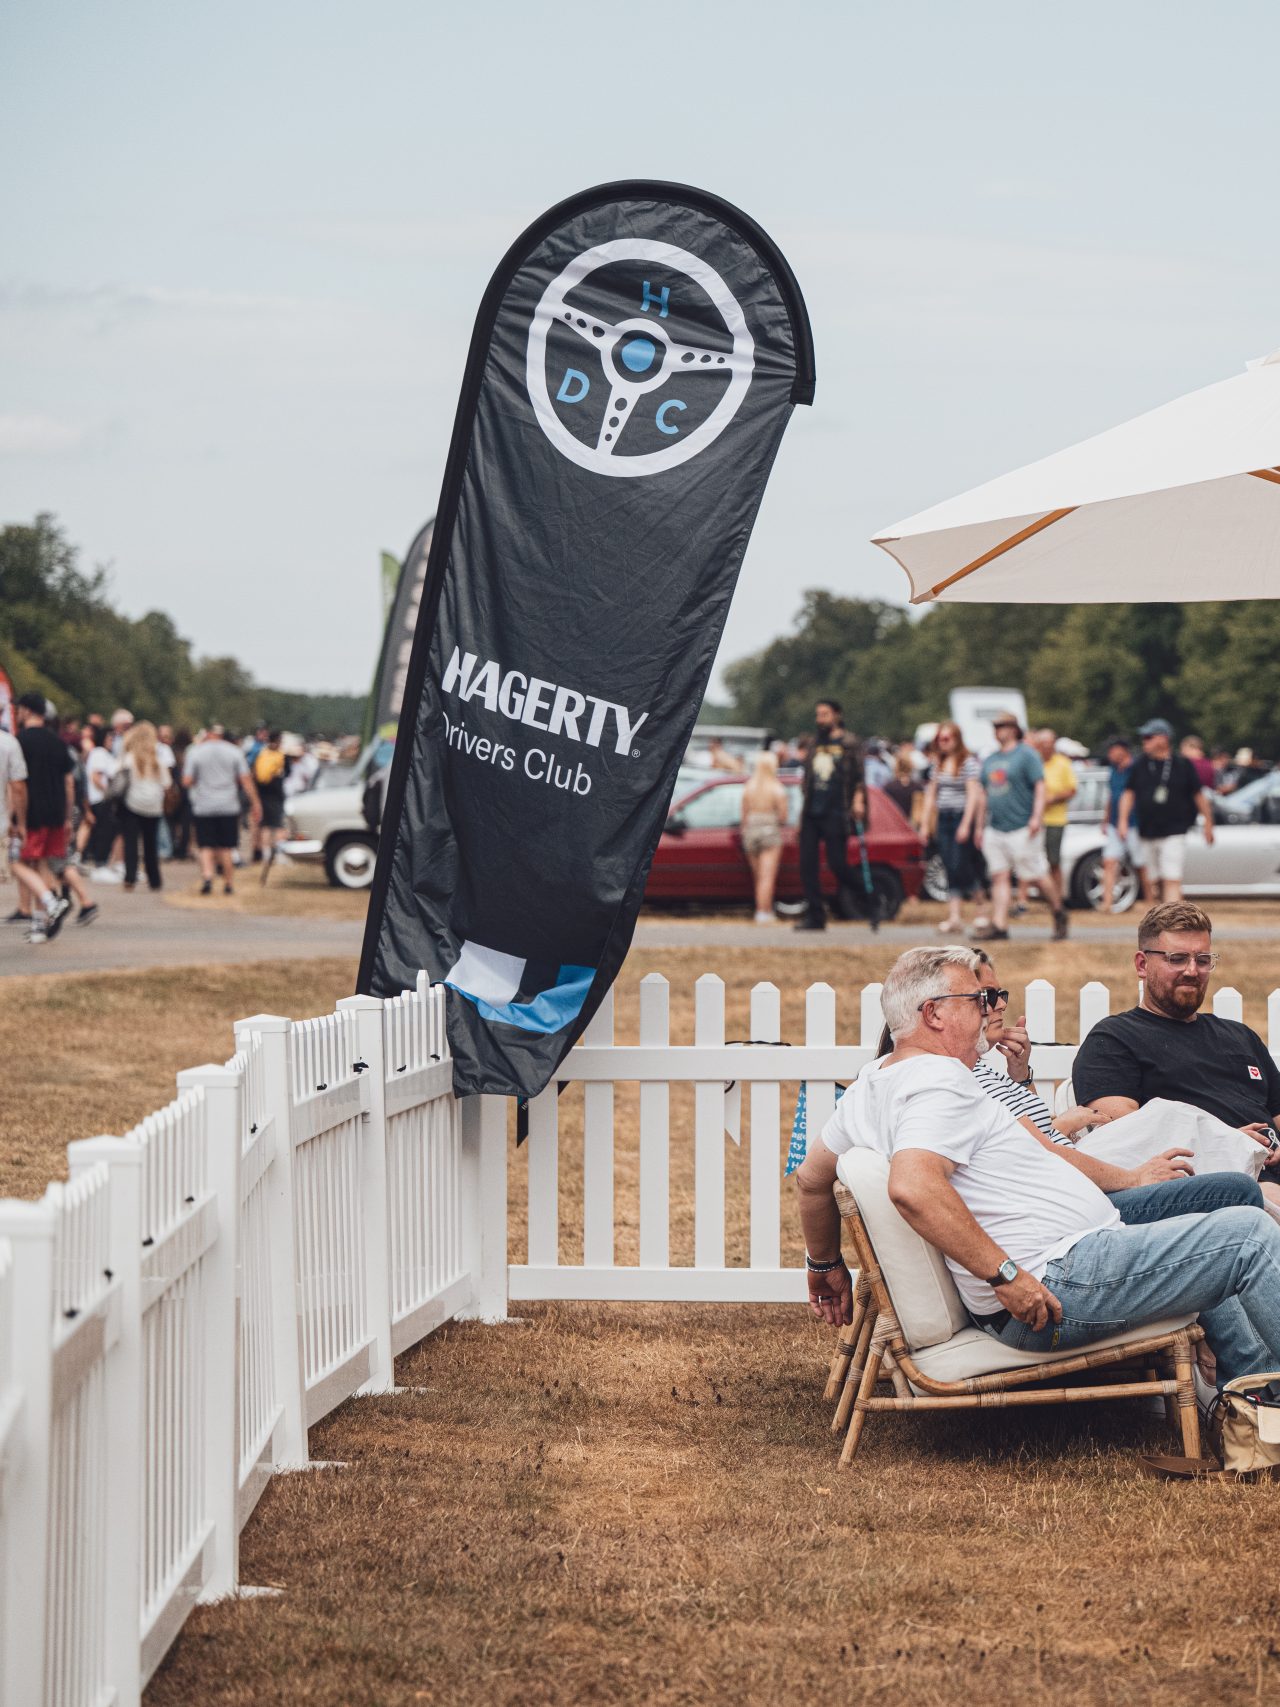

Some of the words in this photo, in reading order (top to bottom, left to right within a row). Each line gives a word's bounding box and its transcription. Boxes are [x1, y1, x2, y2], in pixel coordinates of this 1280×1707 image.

[640, 281, 670, 318] H
[556, 368, 590, 403] D
[655, 399, 687, 434] C
[524, 748, 592, 796] Club
